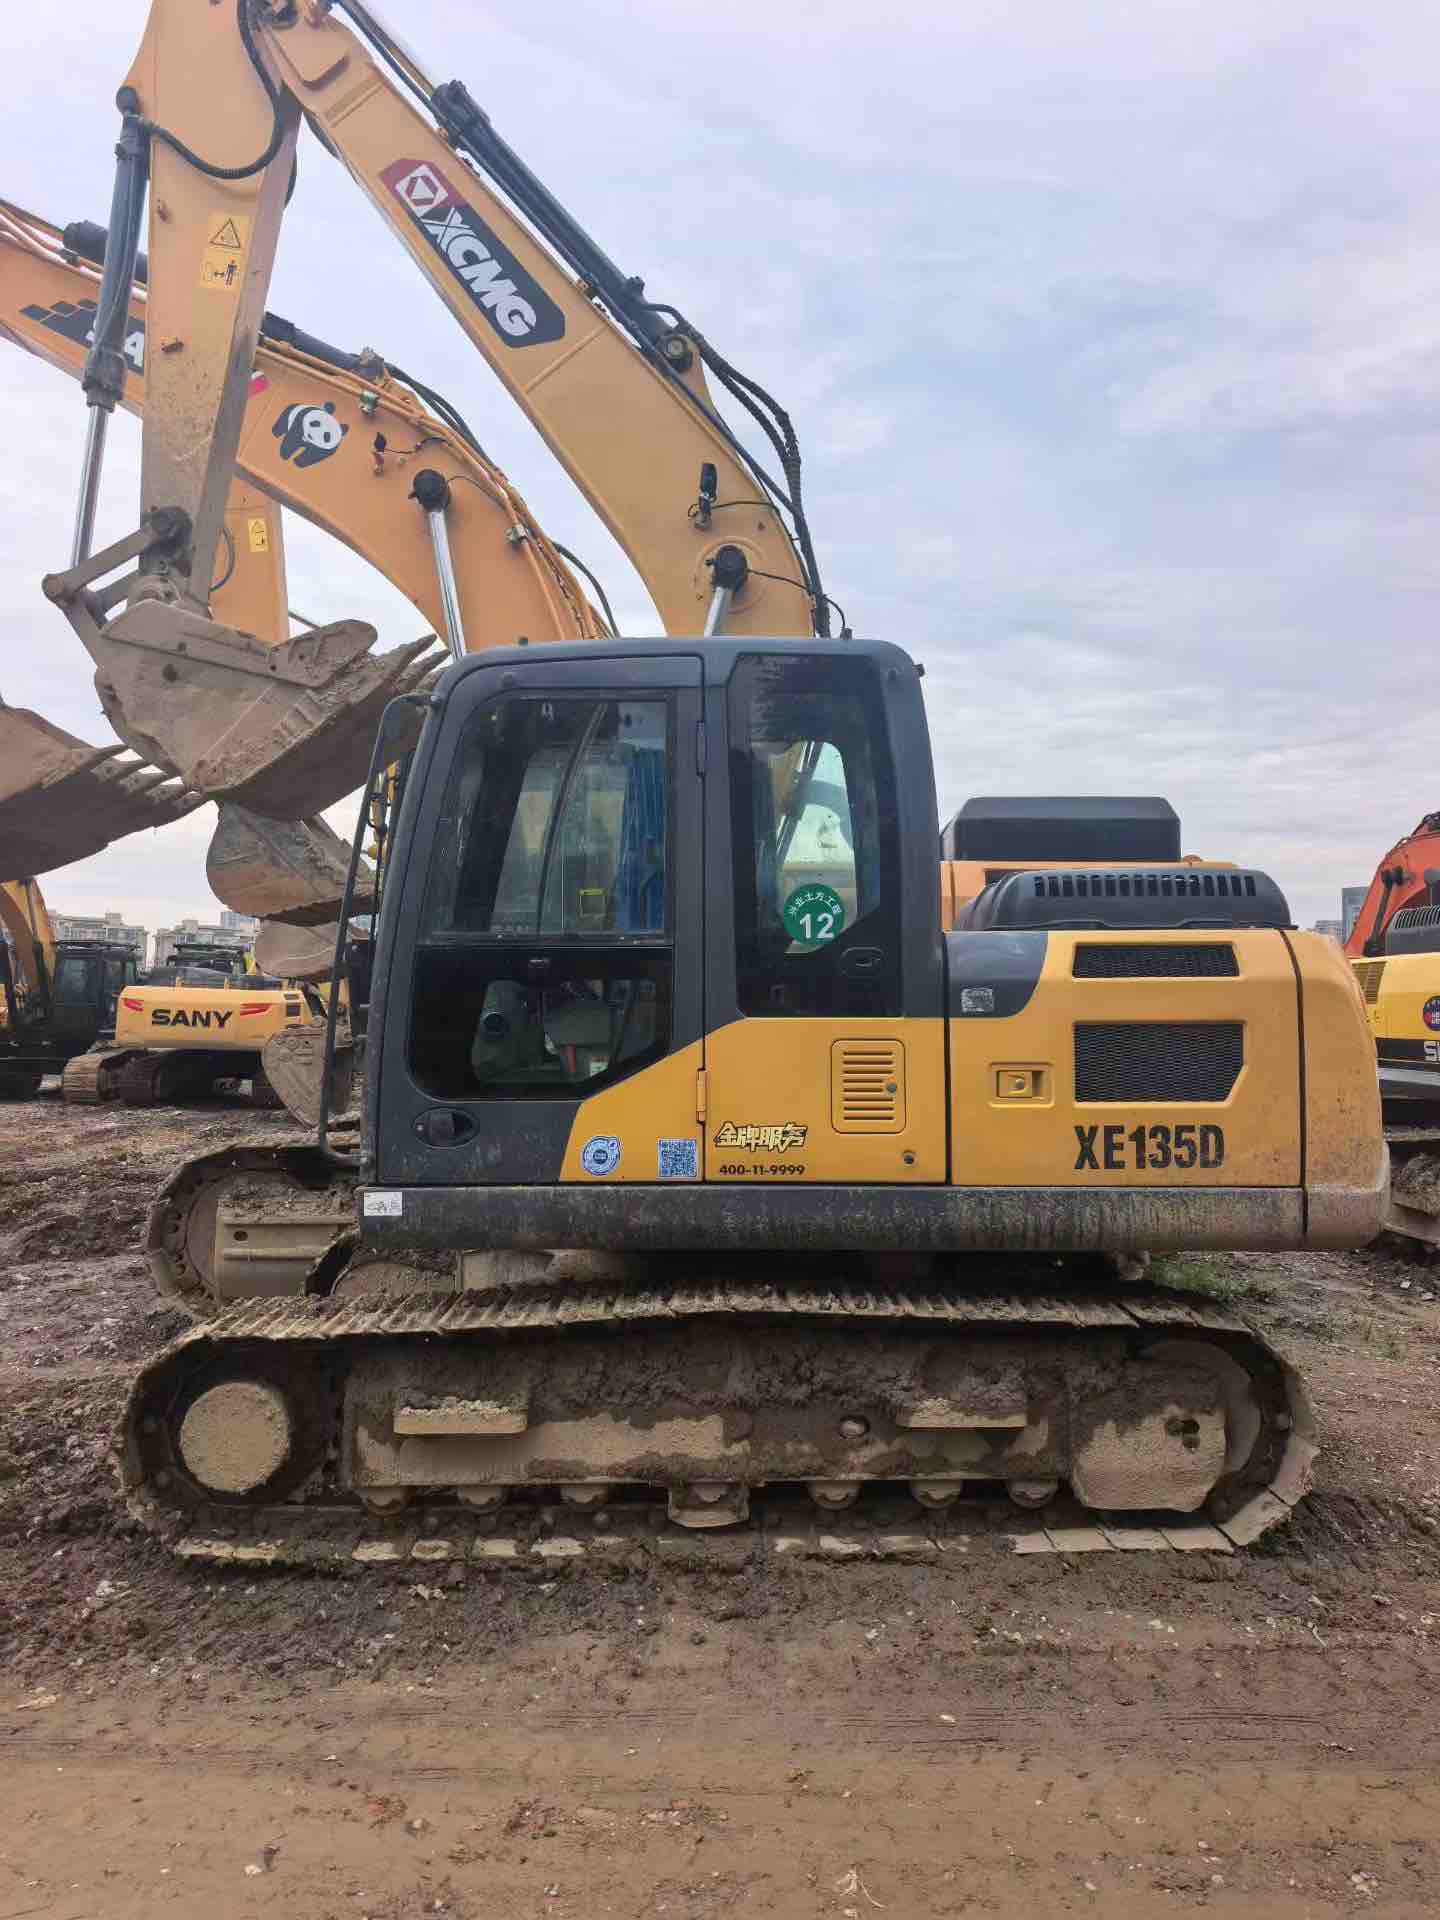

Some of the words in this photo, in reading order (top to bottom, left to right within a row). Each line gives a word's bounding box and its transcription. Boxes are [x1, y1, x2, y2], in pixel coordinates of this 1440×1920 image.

[421, 206, 537, 337] XCMG
[799, 912, 835, 940] 12
[152, 1008, 233, 1028] SANY
[716, 1120, 808, 1153] 金牌服务
[1074, 1124, 1225, 1170] XE135D
[719, 1163, 806, 1176] 400-11-9999
